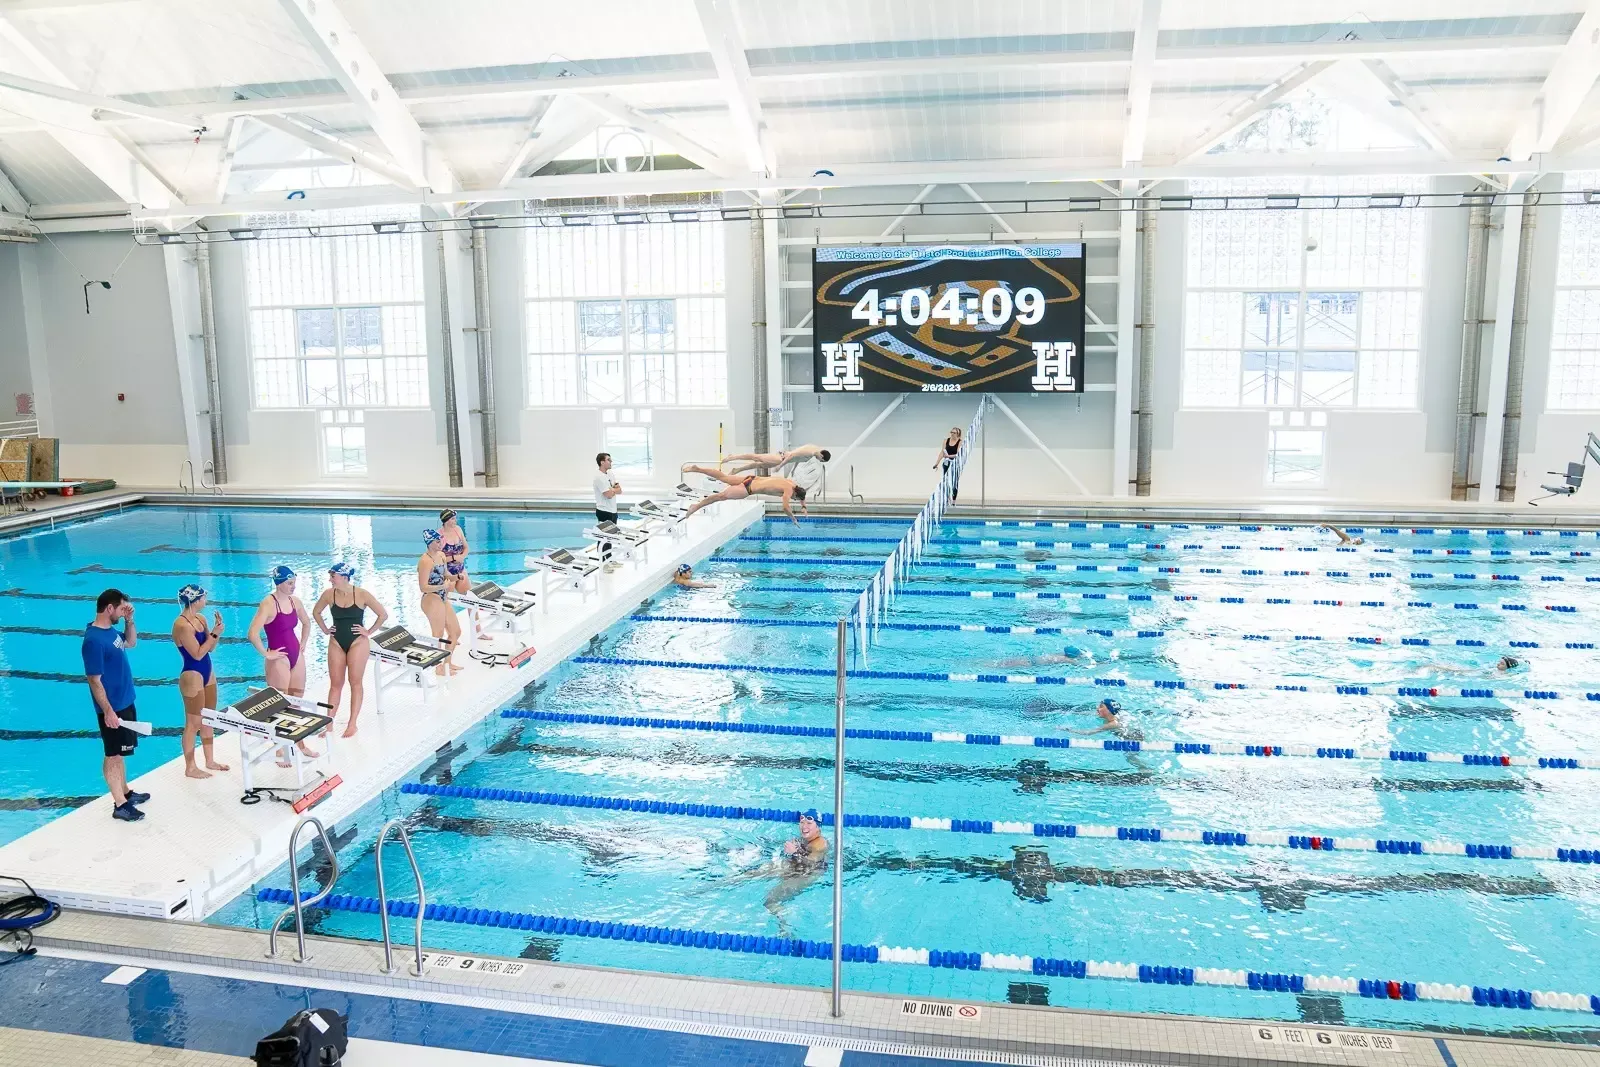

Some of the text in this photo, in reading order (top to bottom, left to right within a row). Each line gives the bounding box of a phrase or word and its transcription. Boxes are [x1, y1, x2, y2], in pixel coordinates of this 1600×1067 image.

[836, 250, 880, 260] Welcome
[882, 250, 892, 259] to
[894, 250, 910, 259] the
[912, 249, 943, 259] Bristol
[946, 248, 967, 258] Pool
[978, 247, 1022, 258] Hamilton
[1024, 247, 1061, 257] College
[851, 286, 1046, 326] 4:04:09
[821, 342, 864, 391] H
[1031, 341, 1076, 391] H
[921, 383, 962, 392] 2/6/2023
[506, 620, 511, 629] 3
[415, 673, 420, 683] 2
[243, 693, 283, 718] CONTINENTALS
[290, 746, 295, 756] 1
[433, 955, 455, 967] FEET
[459, 958, 475, 970] 9
[476, 960, 503, 973] INCHES
[502, 962, 524, 974] DEEP
[903, 1002, 953, 1017] NO DIVING
[1258, 1028, 1394, 1050] 6 FEET 6 INCHES DEEP
